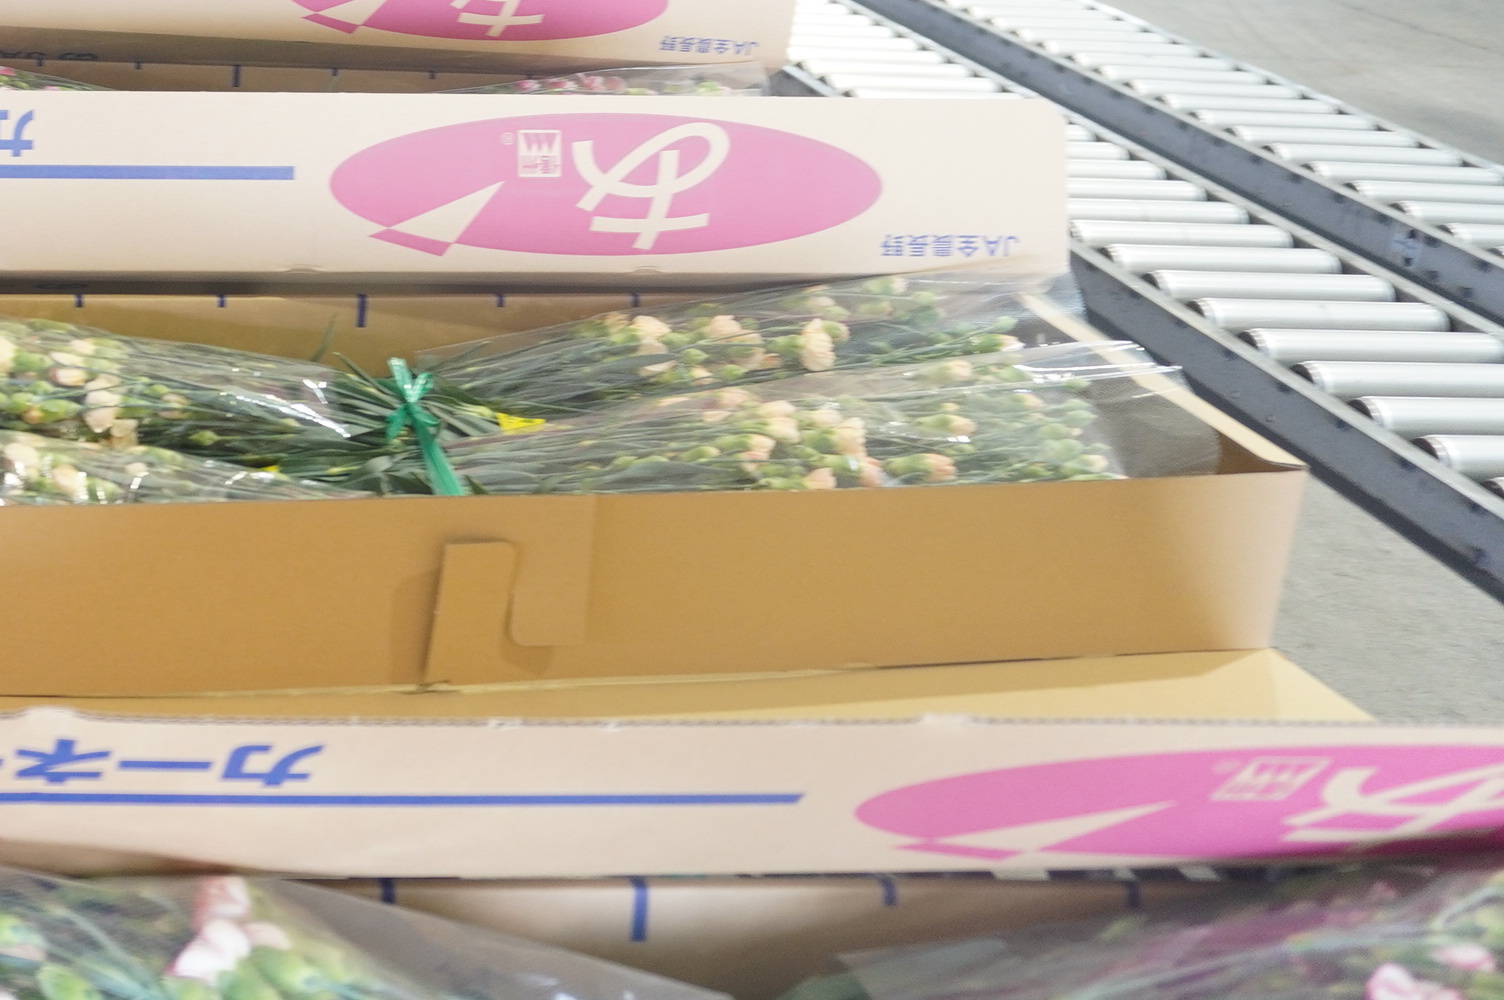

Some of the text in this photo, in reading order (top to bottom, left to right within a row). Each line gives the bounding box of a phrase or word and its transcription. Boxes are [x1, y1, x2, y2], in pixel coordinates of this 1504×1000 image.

[572, 122, 730, 250] あ
[879, 233, 1021, 258] JA全農長野
